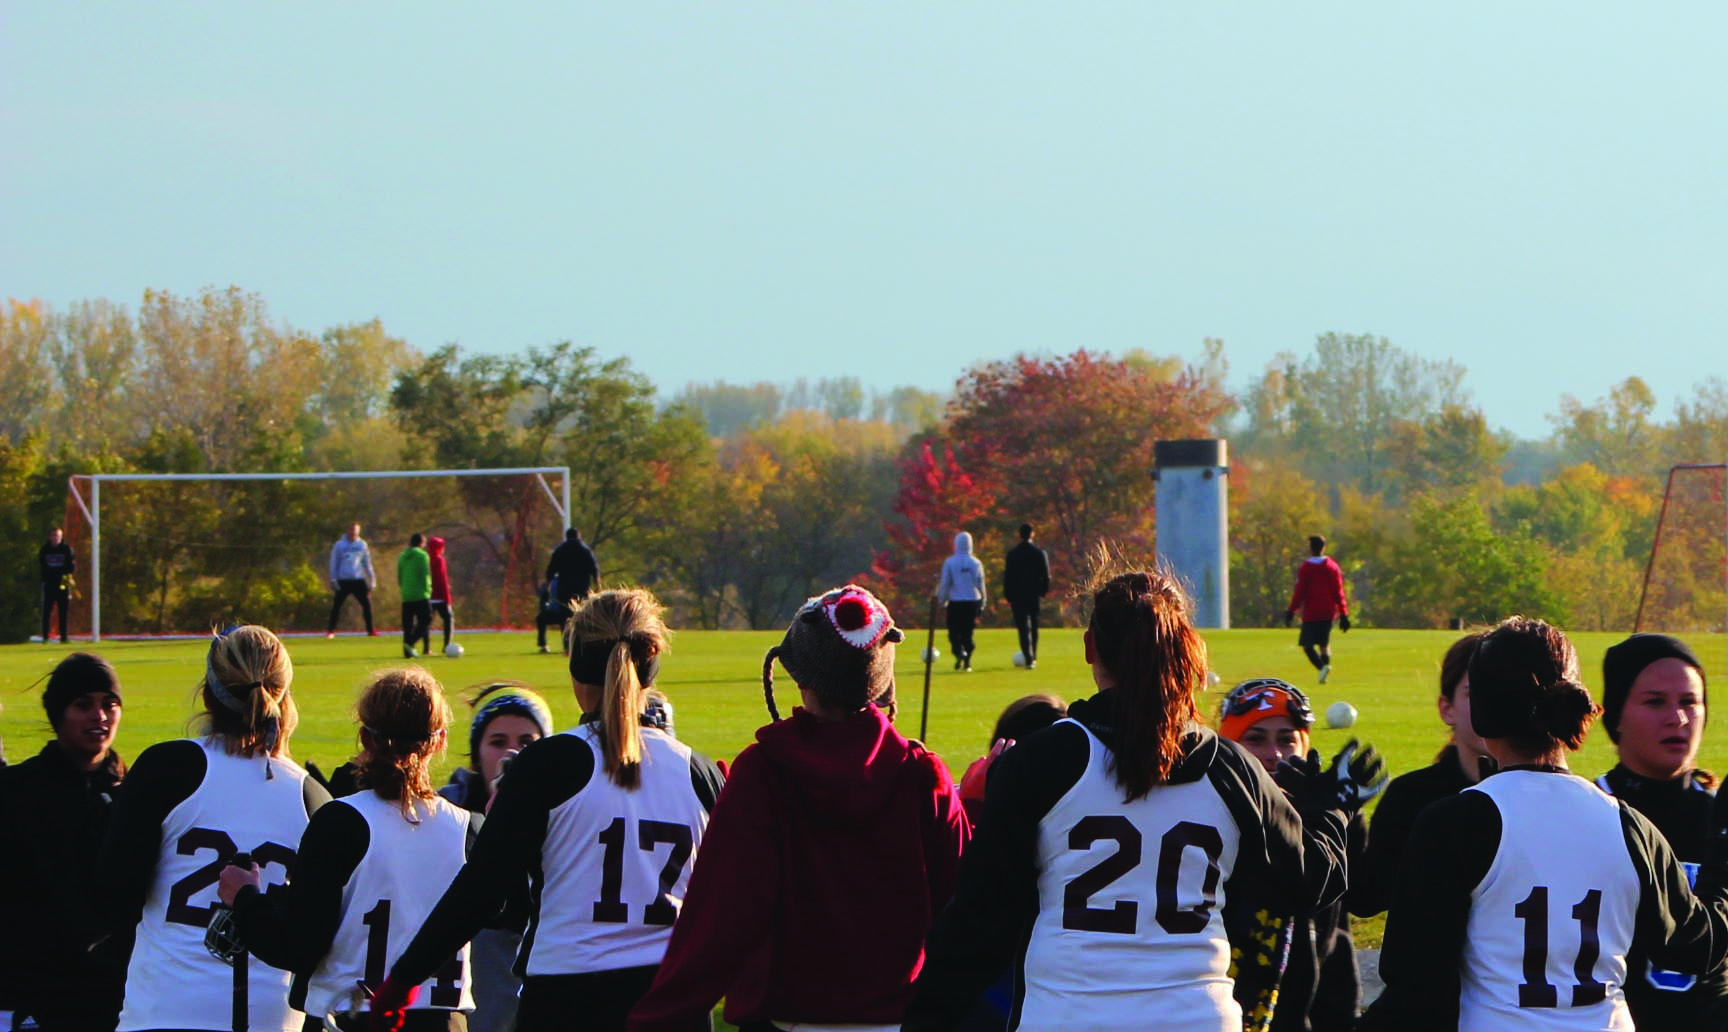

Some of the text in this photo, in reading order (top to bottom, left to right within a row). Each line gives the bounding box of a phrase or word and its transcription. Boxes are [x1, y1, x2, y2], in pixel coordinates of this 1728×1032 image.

[592, 817, 693, 925] 17
[1062, 815, 1224, 935] 20
[1514, 886, 1607, 1008] 11
